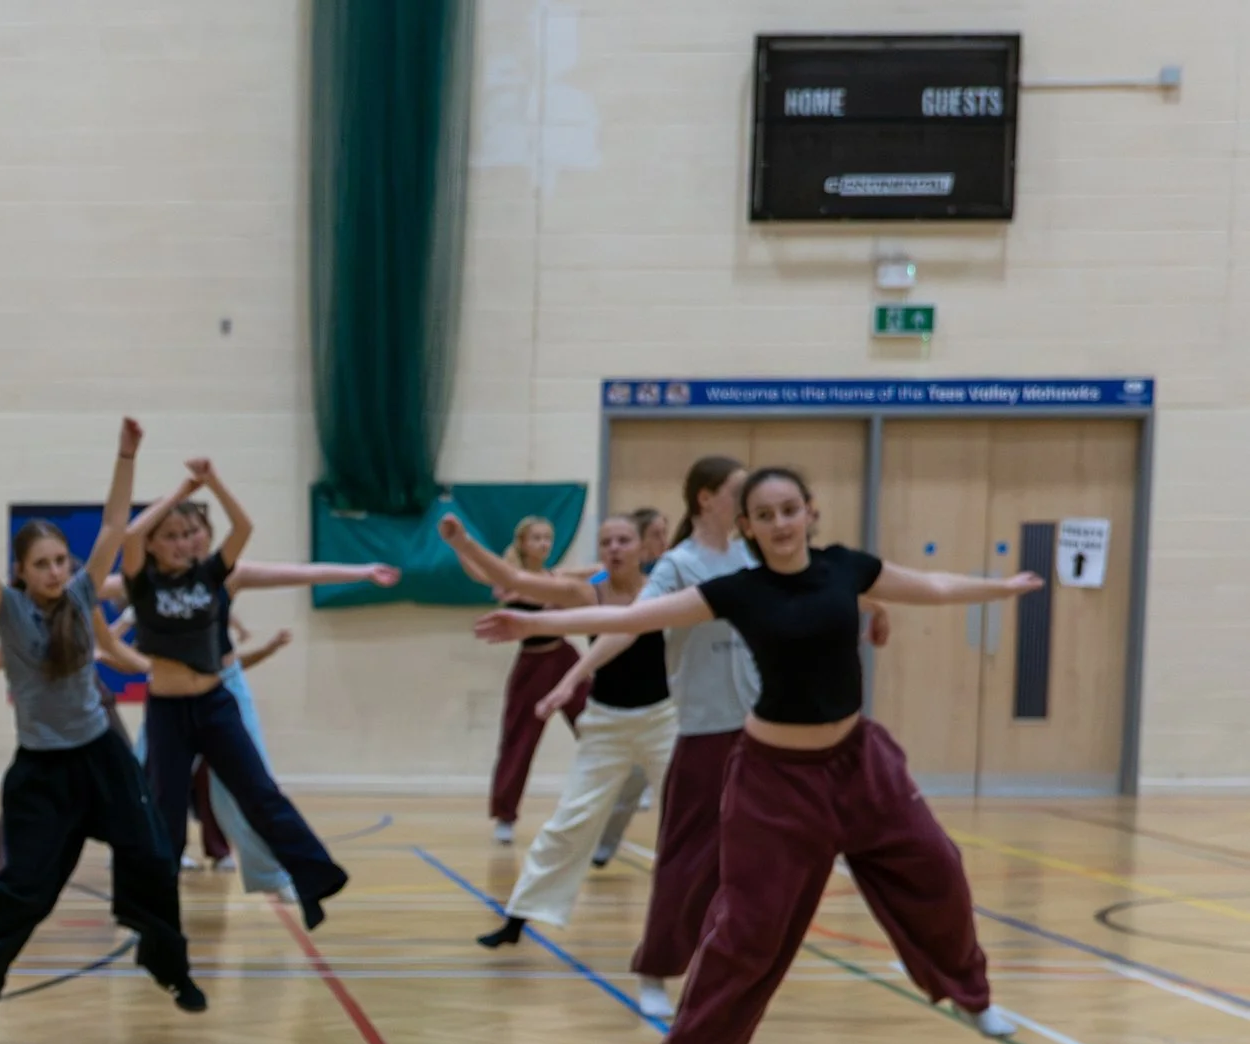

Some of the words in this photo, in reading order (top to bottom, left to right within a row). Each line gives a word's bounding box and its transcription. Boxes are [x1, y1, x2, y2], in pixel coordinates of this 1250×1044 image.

[784, 87, 846, 117] HOME
[922, 86, 1003, 117] GUESTS
[705, 385, 778, 402] Welcome
[782, 386, 798, 402] to
[800, 385, 826, 401] the
[877, 385, 896, 402] of
[898, 384, 923, 400] the
[968, 384, 1020, 405] Valley
[1022, 384, 1100, 401] Mohawks
